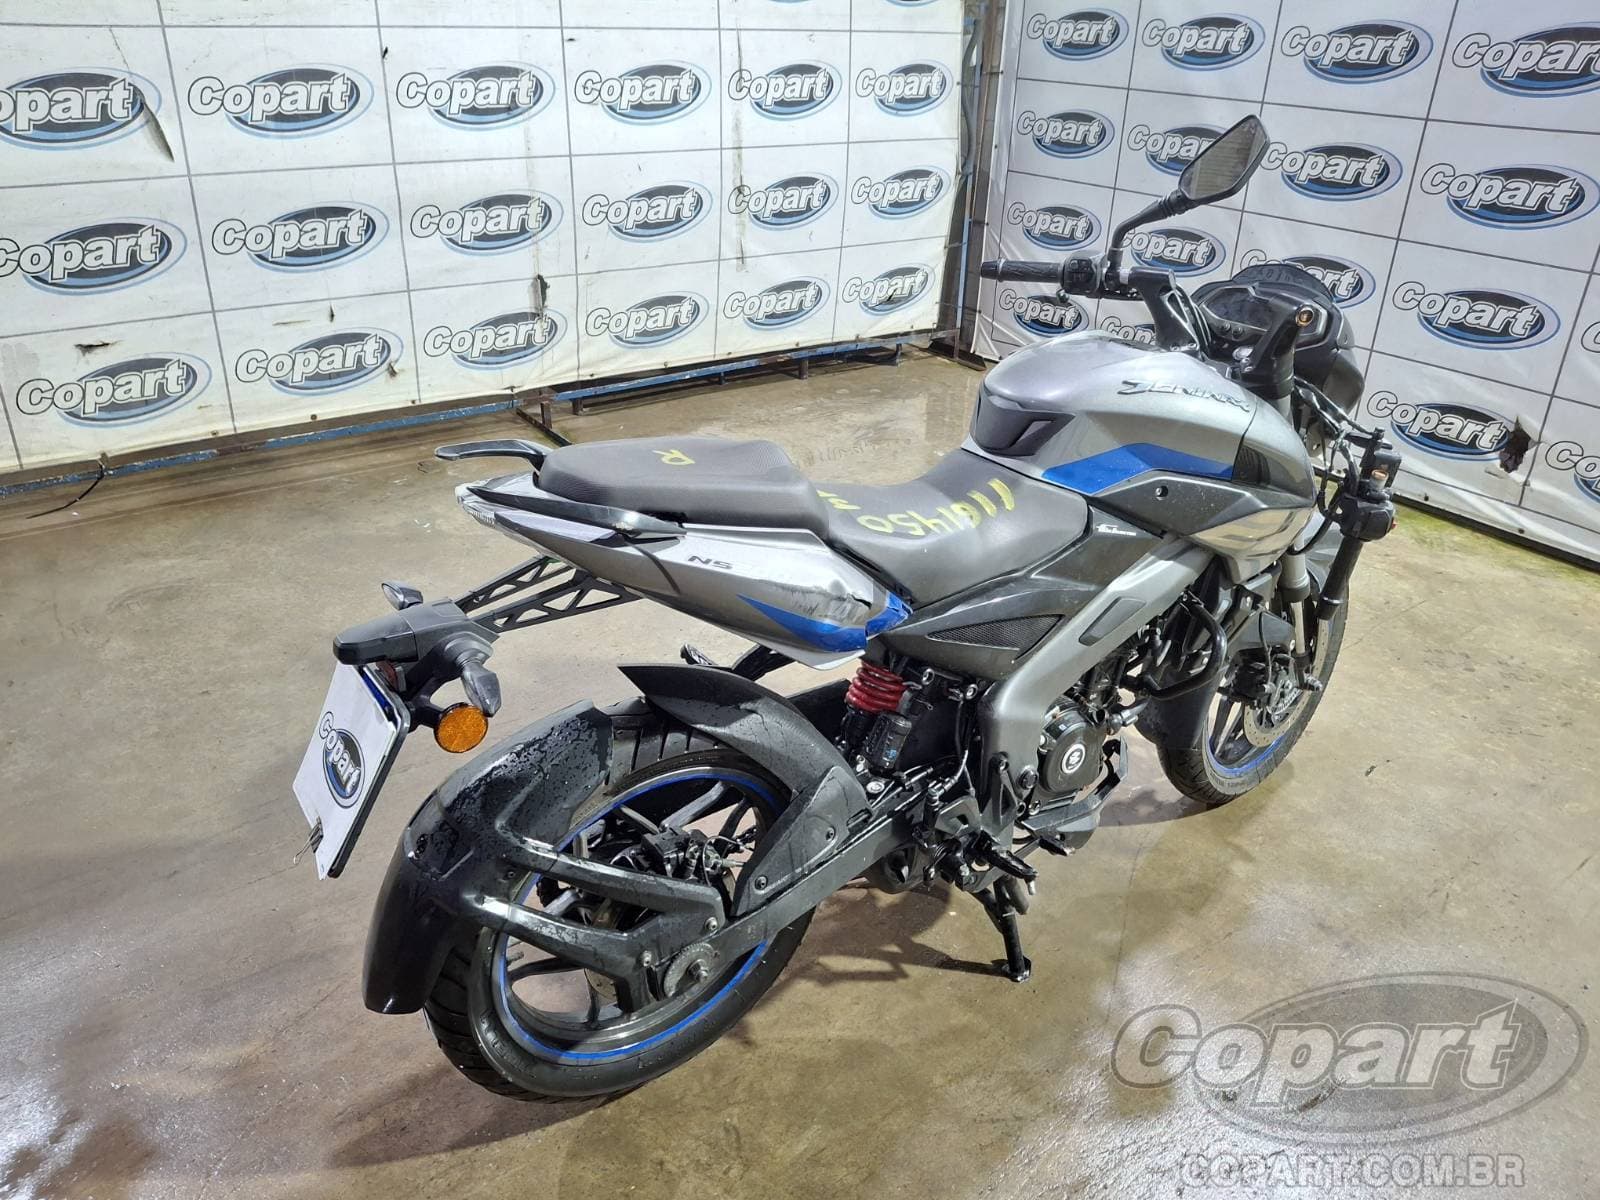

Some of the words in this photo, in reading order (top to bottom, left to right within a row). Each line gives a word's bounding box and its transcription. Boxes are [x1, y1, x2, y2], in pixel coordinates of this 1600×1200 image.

[1027, 13, 1116, 48] Copart
[1142, 19, 1250, 55] Copart
[1281, 26, 1413, 66] Copart
[188, 73, 350, 122] Copart
[397, 70, 536, 114] Copart
[574, 69, 695, 110] Copart
[729, 68, 828, 107] Copart
[855, 67, 943, 104] Copart
[1017, 111, 1104, 144] Copart
[1127, 124, 1216, 163] Copa
[1260, 142, 1385, 187] Copart
[583, 187, 704, 228] Copart
[729, 177, 824, 215] Copart
[851, 168, 943, 206] Copart
[1421, 163, 1579, 214] Copart
[212, 210, 366, 259] Copart
[410, 197, 543, 242] Copart
[1007, 202, 1091, 240] Copart
[723, 280, 821, 322] Copart
[842, 268, 927, 307] Copart
[586, 296, 697, 337] Copart
[999, 289, 1079, 329] Copart
[1392, 281, 1540, 337] Copart
[423, 315, 552, 358] Copart
[235, 333, 386, 383] Copart
[17, 359, 188, 416] Copart
[1366, 391, 1509, 449] Copart
[687, 555, 733, 570] NS
[319, 711, 361, 797] Copart
